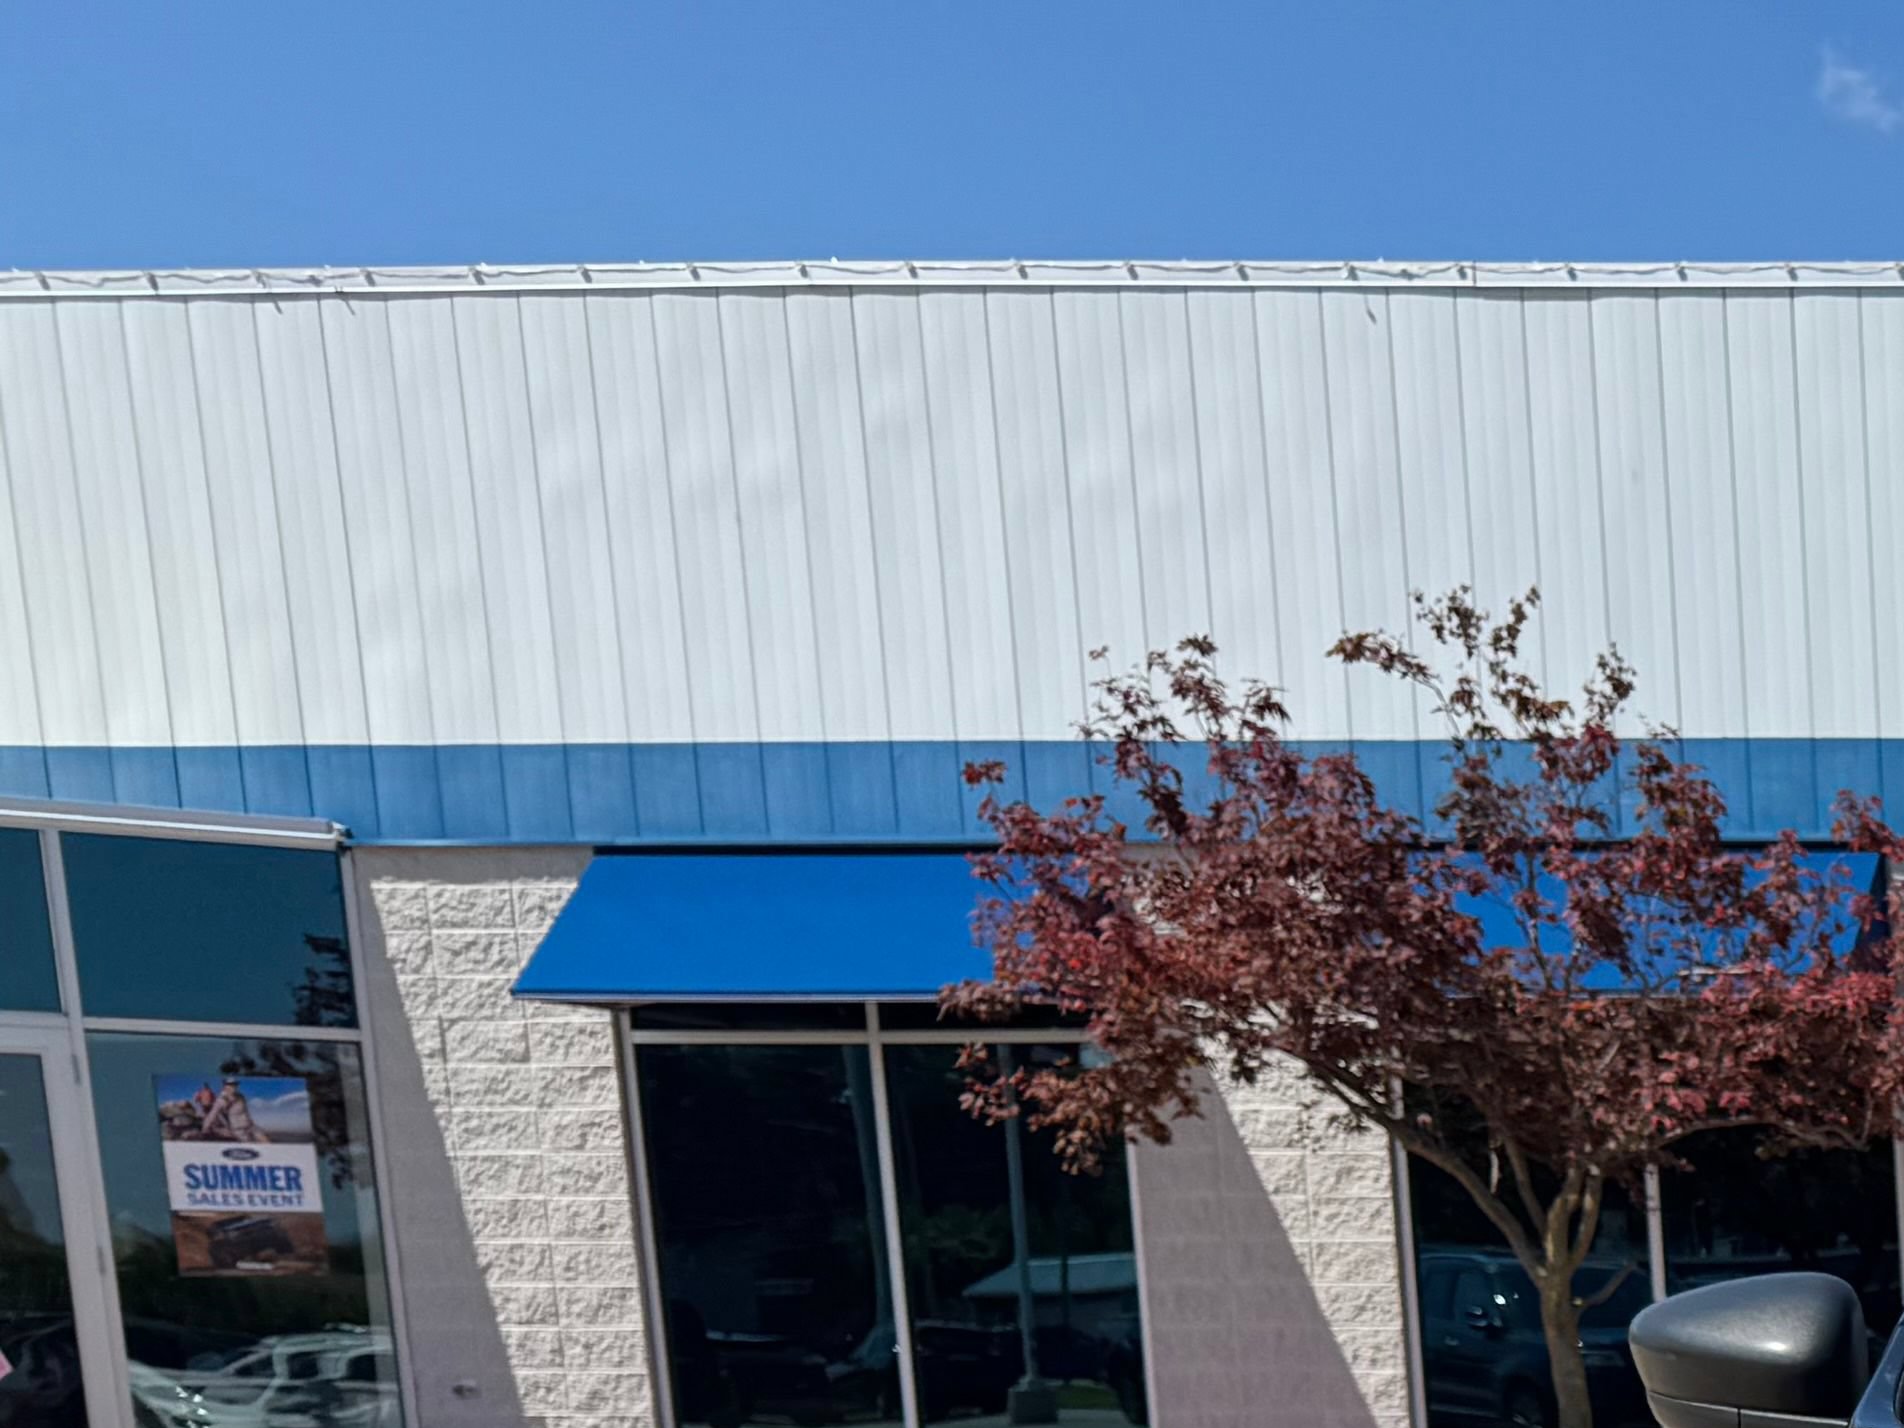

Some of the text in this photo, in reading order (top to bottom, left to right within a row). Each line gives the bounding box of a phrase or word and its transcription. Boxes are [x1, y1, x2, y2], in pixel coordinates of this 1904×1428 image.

[184, 1163, 303, 1191] SUMMER
[187, 1192, 304, 1206] SALES EVENT
